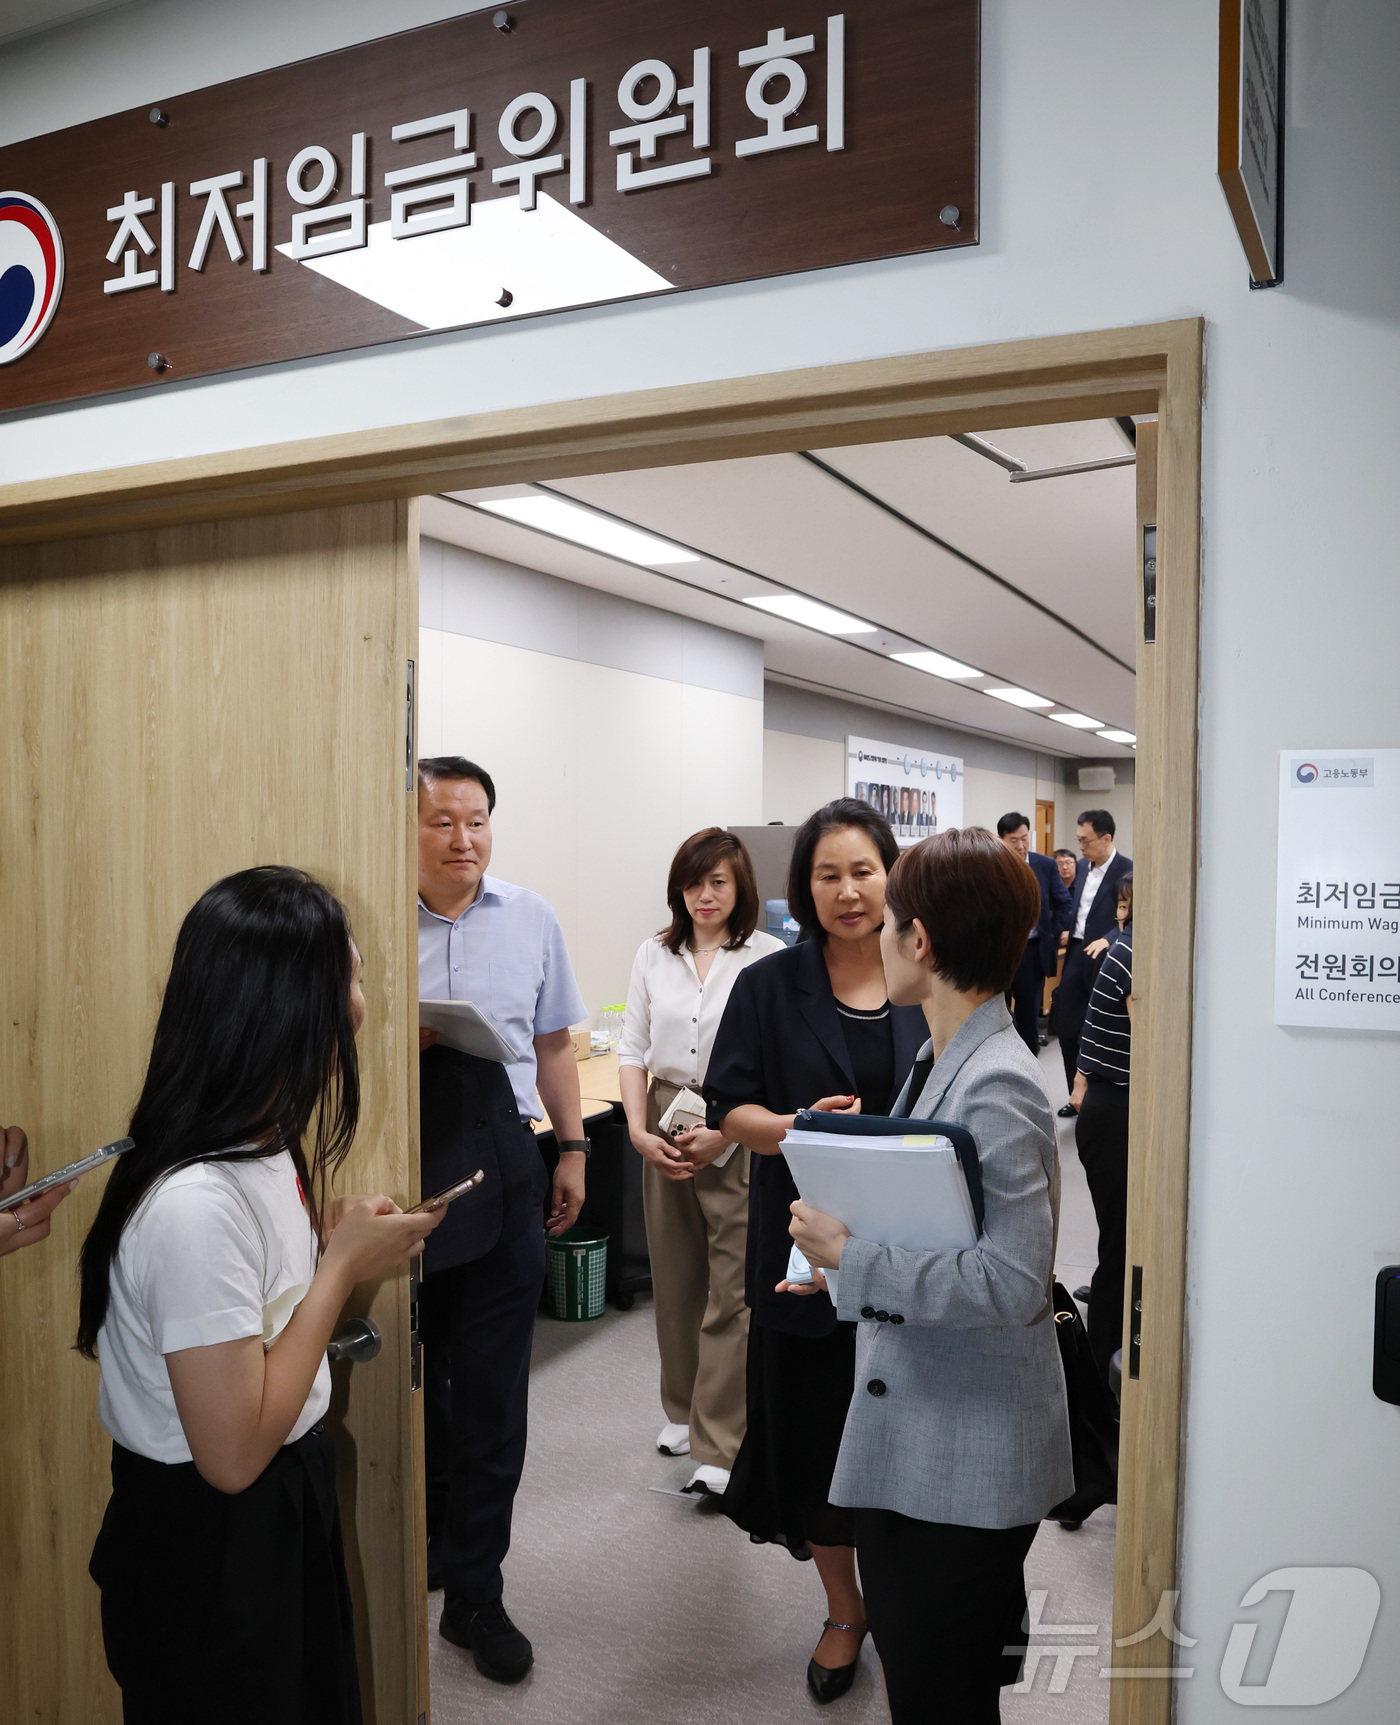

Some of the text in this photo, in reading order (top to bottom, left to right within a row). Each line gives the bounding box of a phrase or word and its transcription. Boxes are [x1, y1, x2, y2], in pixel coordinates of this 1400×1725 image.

[103, 14, 846, 295] 최저임금위원회
[1323, 768, 1368, 778] 고용노동부
[1296, 881, 1400, 909] 최저임금
[1297, 915, 1399, 934] Minimum Wag
[1295, 953, 1400, 983] 전원회의
[1295, 987, 1400, 1004] All Conference
